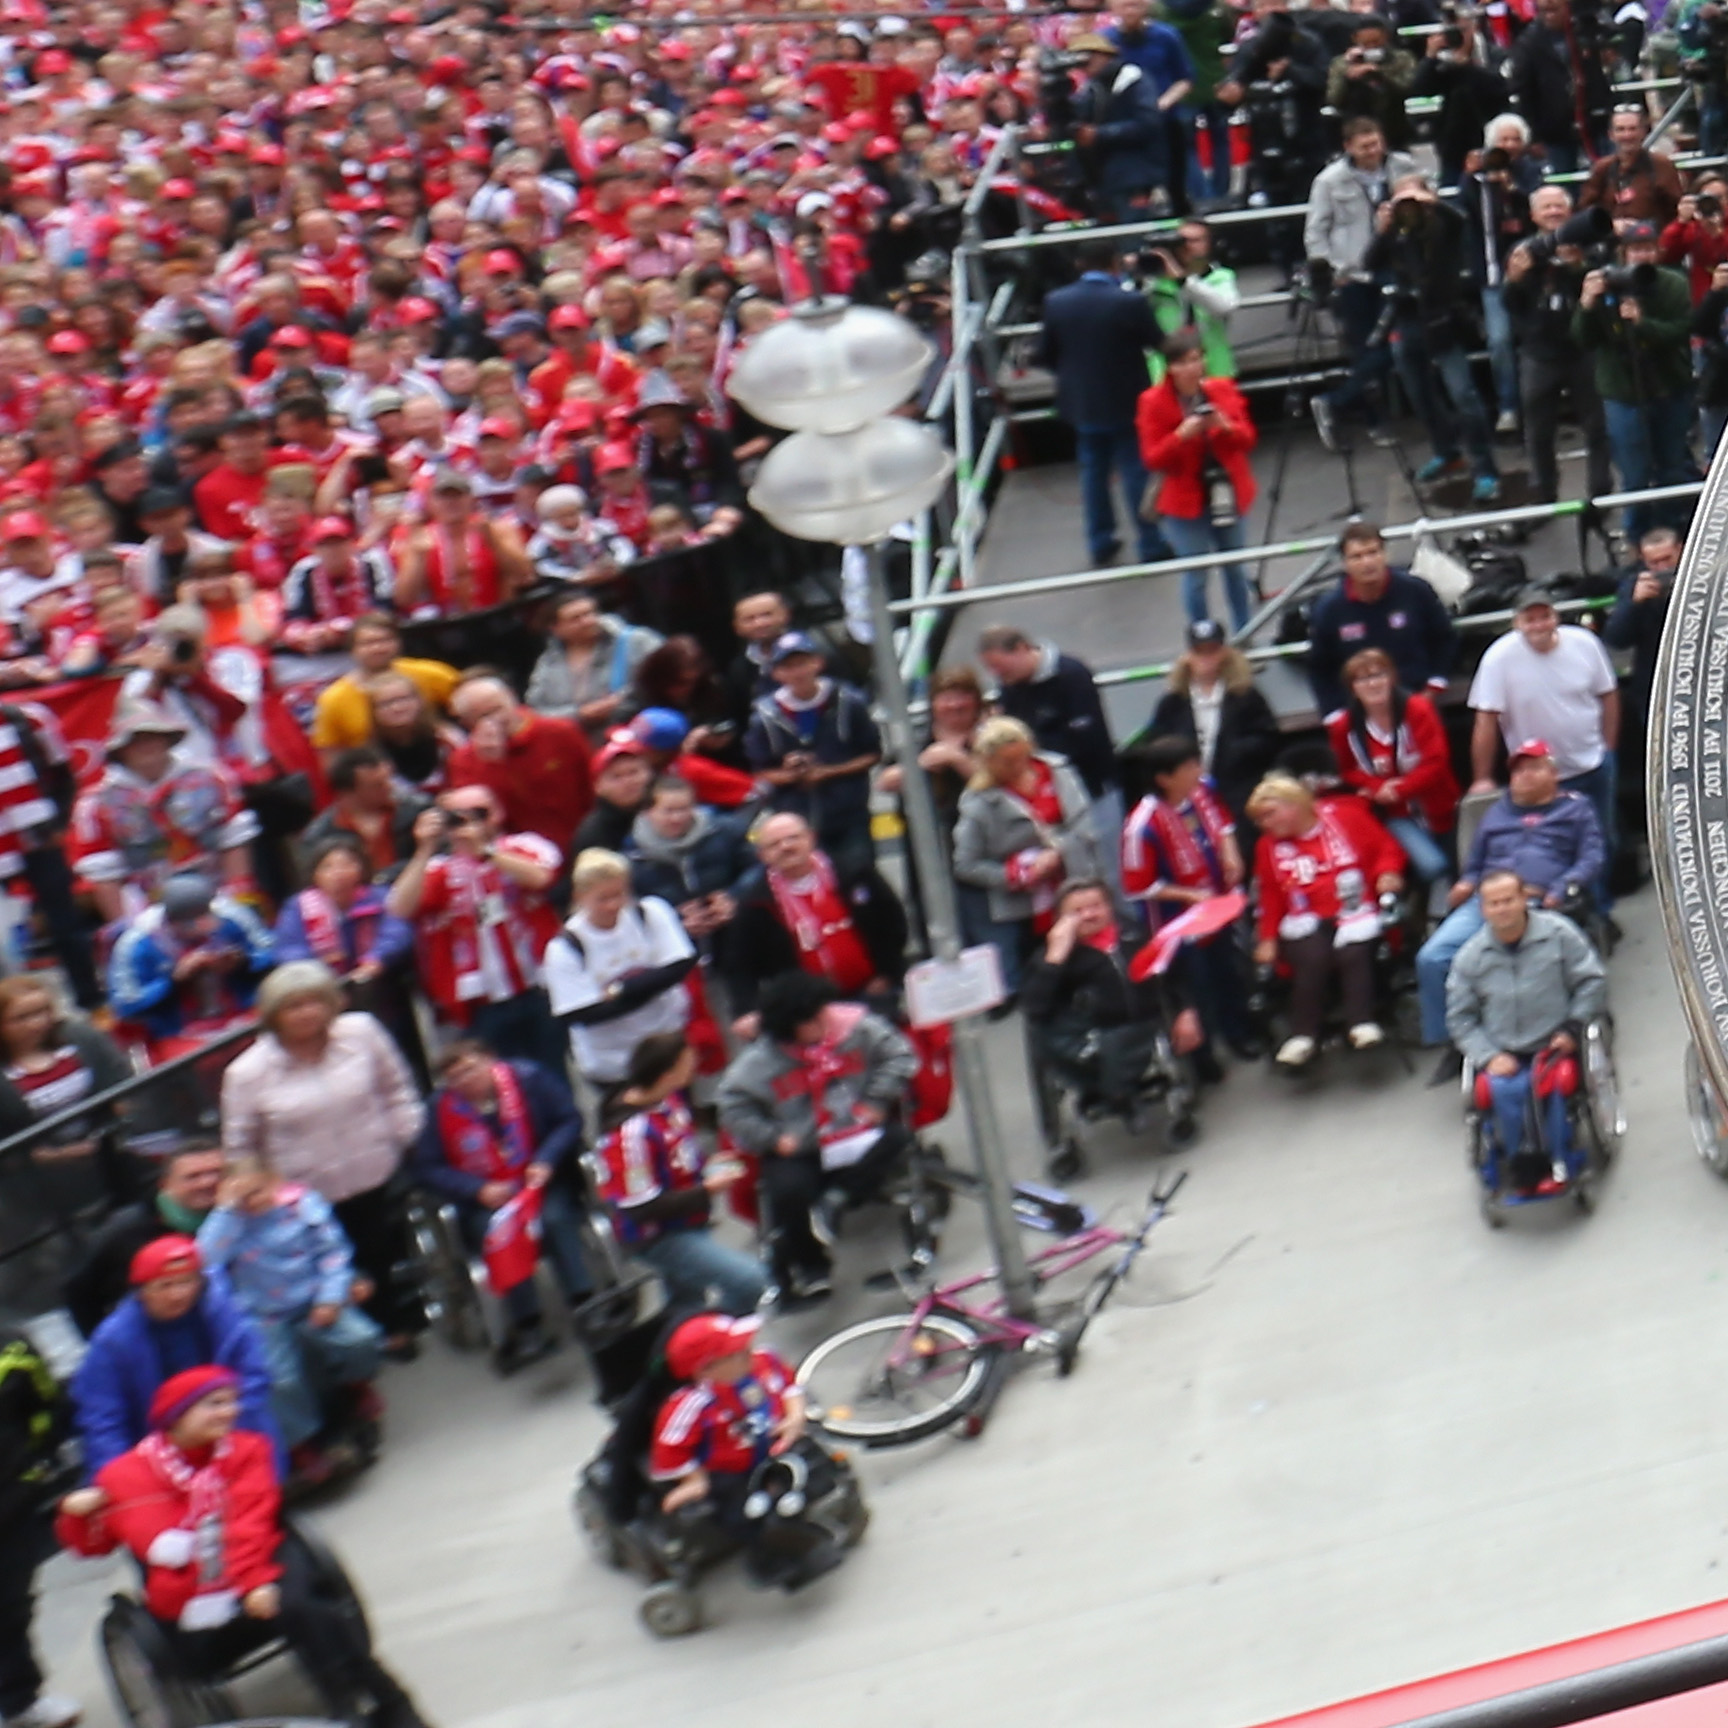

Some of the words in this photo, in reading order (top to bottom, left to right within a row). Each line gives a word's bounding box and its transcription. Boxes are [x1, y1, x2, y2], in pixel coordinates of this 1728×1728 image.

[1674, 596, 1705, 695] BORUSSIA
[1672, 702, 1691, 727] BV
[1672, 730, 1689, 768] 1996
[1703, 729, 1721, 754] BV
[1704, 759, 1723, 798] 2011
[1670, 783, 1703, 905] DORTMUND
